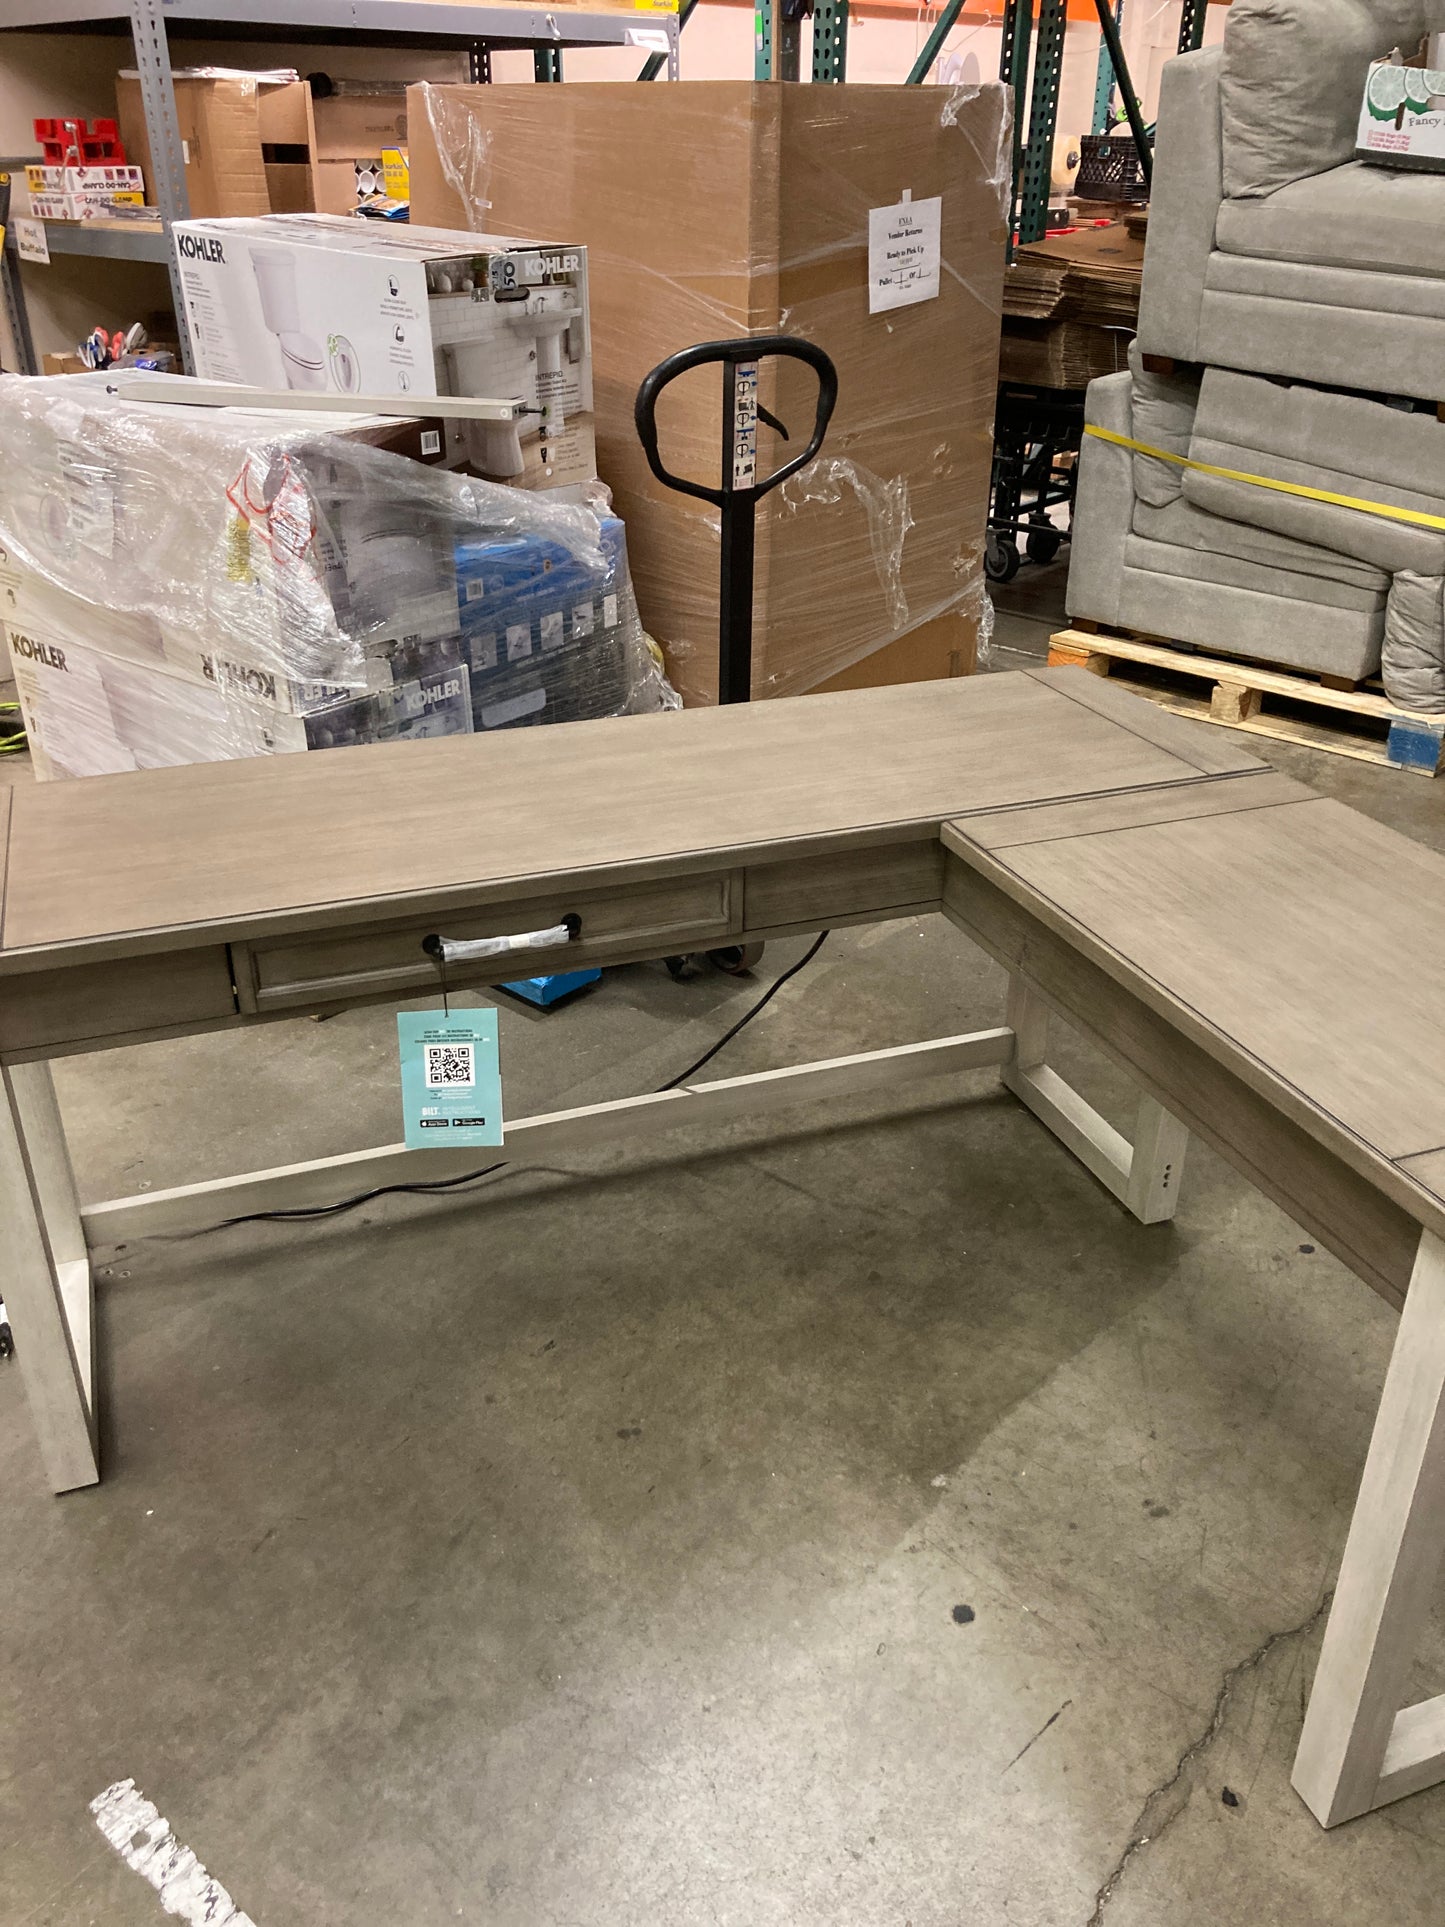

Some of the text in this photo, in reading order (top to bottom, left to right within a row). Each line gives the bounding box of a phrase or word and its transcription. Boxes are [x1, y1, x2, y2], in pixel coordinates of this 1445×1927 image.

[1409, 117, 1441, 128] Fancy
[177, 234, 226, 264] KOHLER
[525, 255, 579, 276] KOHLER
[11, 632, 68, 672] KOHLER
[406, 679, 460, 711] KOHLER
